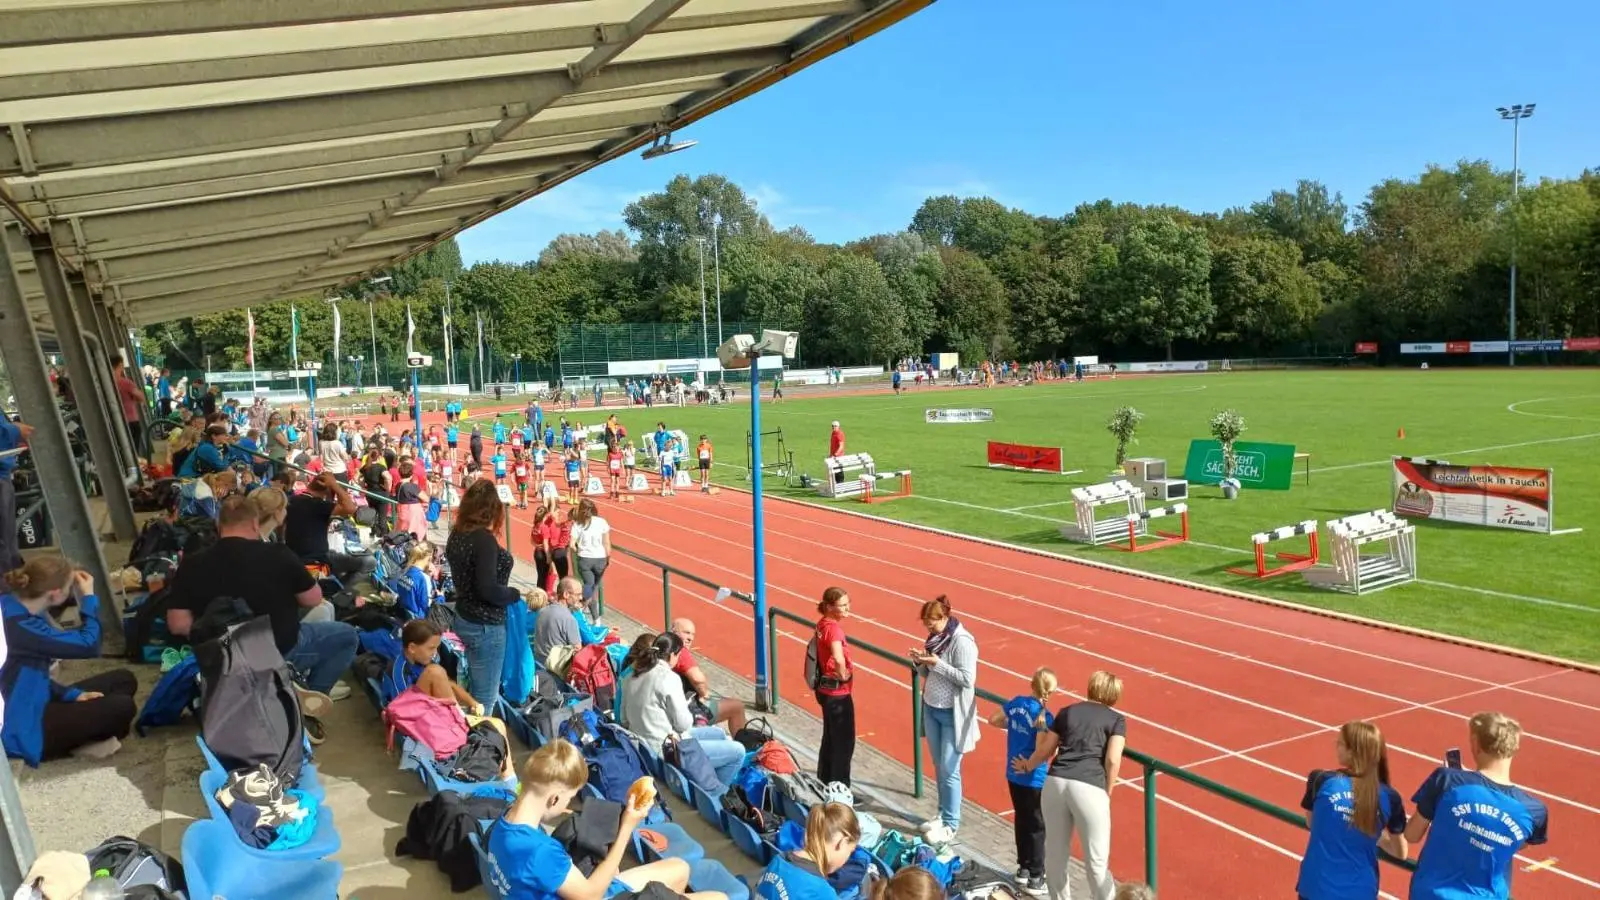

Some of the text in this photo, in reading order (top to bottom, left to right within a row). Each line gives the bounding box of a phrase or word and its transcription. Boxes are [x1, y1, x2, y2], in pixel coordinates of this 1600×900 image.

[591, 480, 600, 491] 3
[1496, 475, 1506, 485] in
[1509, 476, 1546, 488] Taucha
[1152, 486, 1159, 497] 3
[17, 507, 36, 544] adids
[1451, 803, 1472, 817] SSV
[1500, 811, 1525, 841] Torgau
